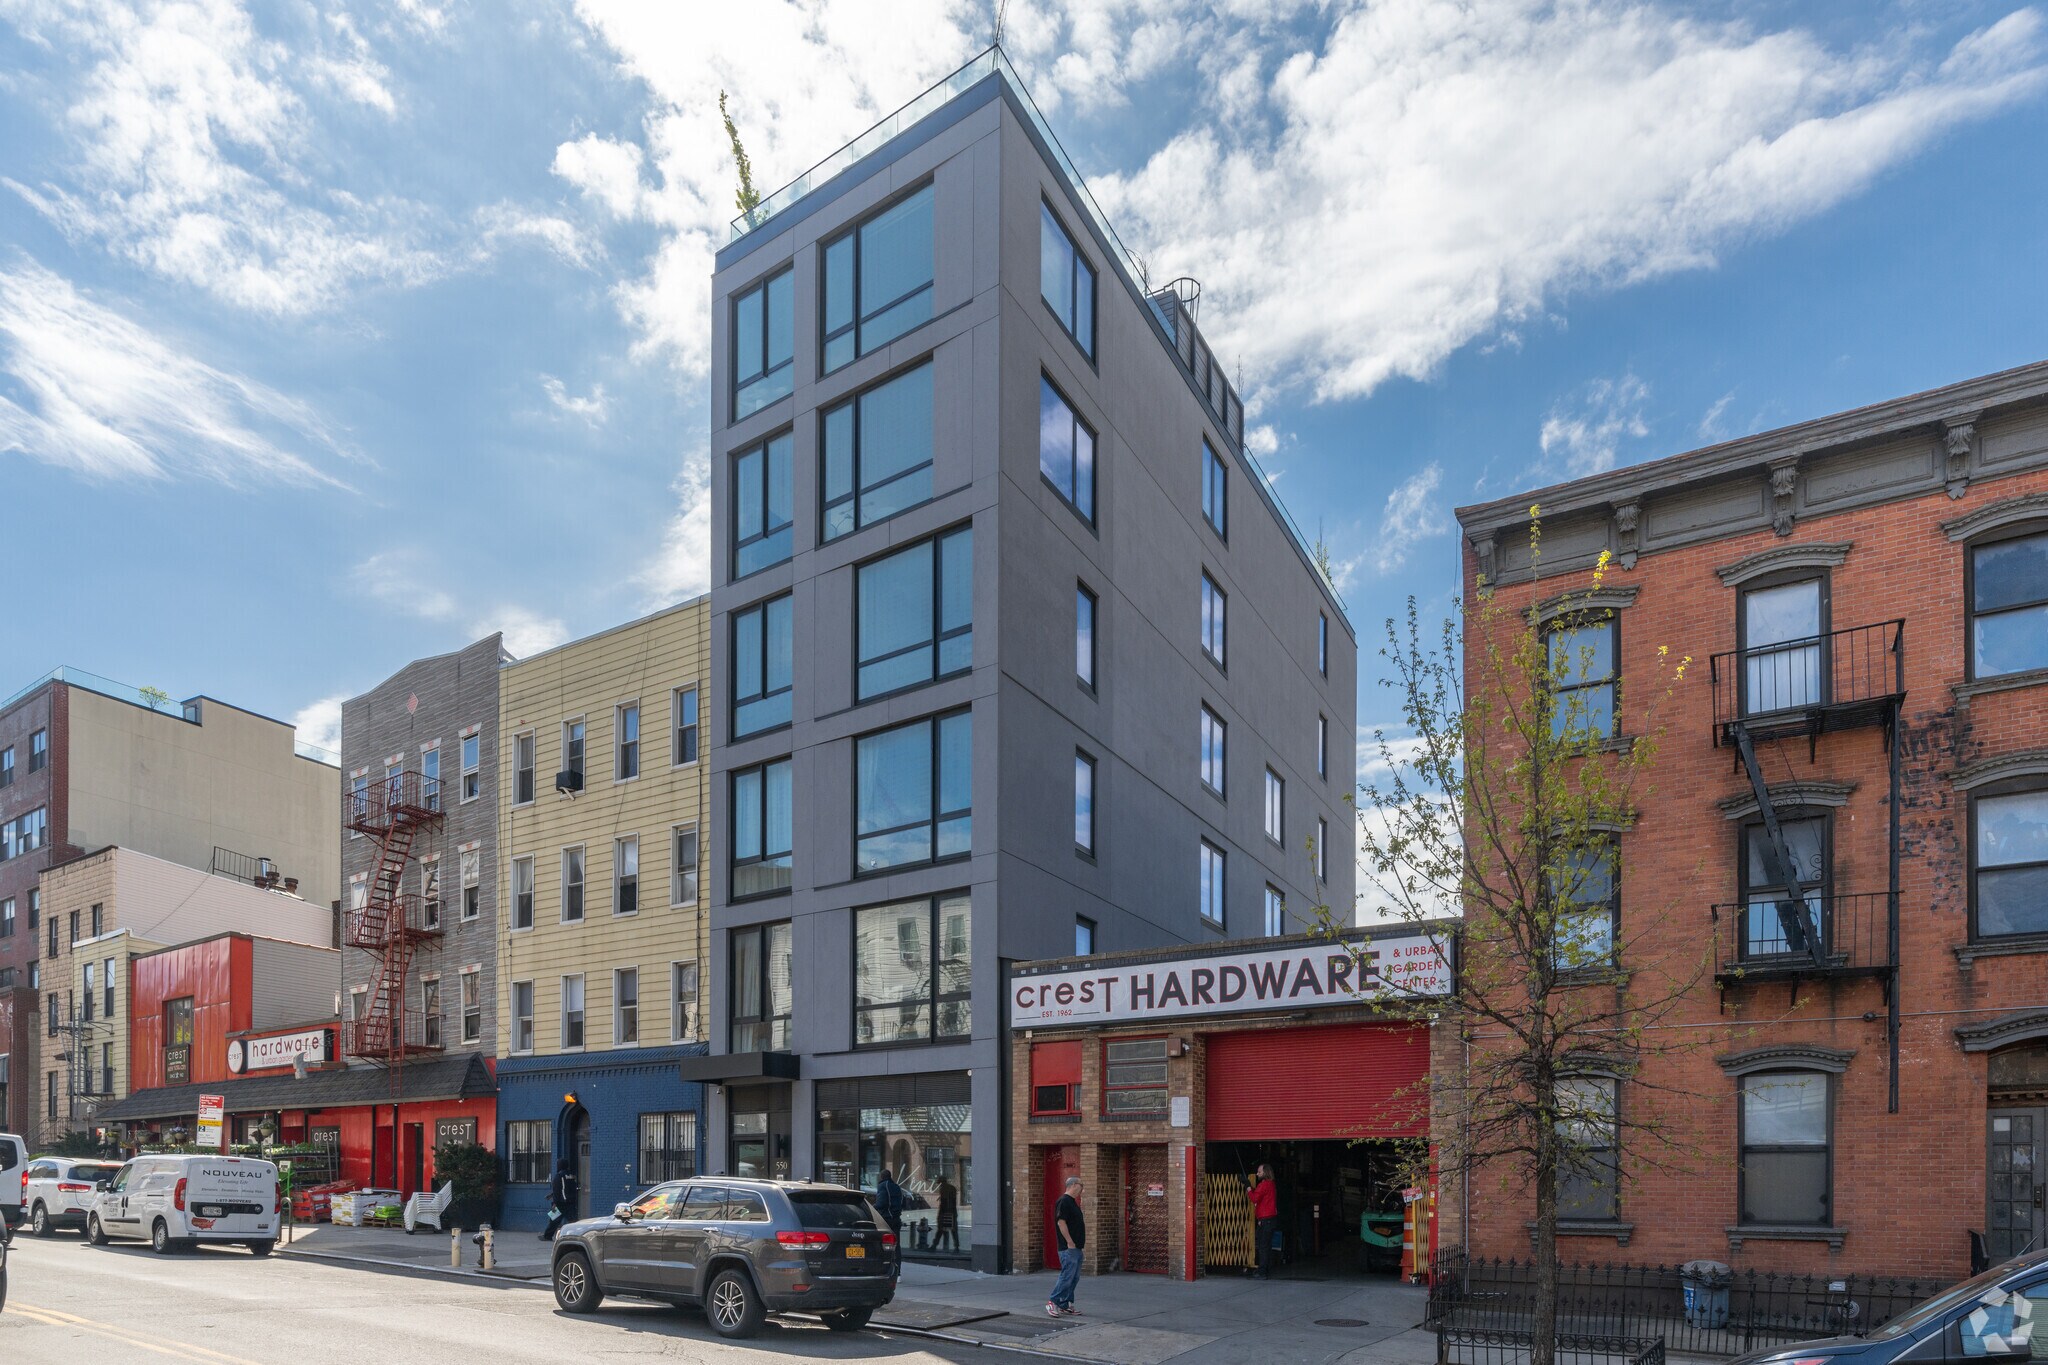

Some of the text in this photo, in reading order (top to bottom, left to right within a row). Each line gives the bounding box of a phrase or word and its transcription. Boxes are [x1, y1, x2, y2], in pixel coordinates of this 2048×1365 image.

[1130, 950, 1380, 1011] HARDWARE
[1057, 1009, 1073, 1017] 1962
[252, 1036, 319, 1057] hardware
[776, 1161, 788, 1170] 550
[202, 1169, 262, 1179] NOUVEAU
